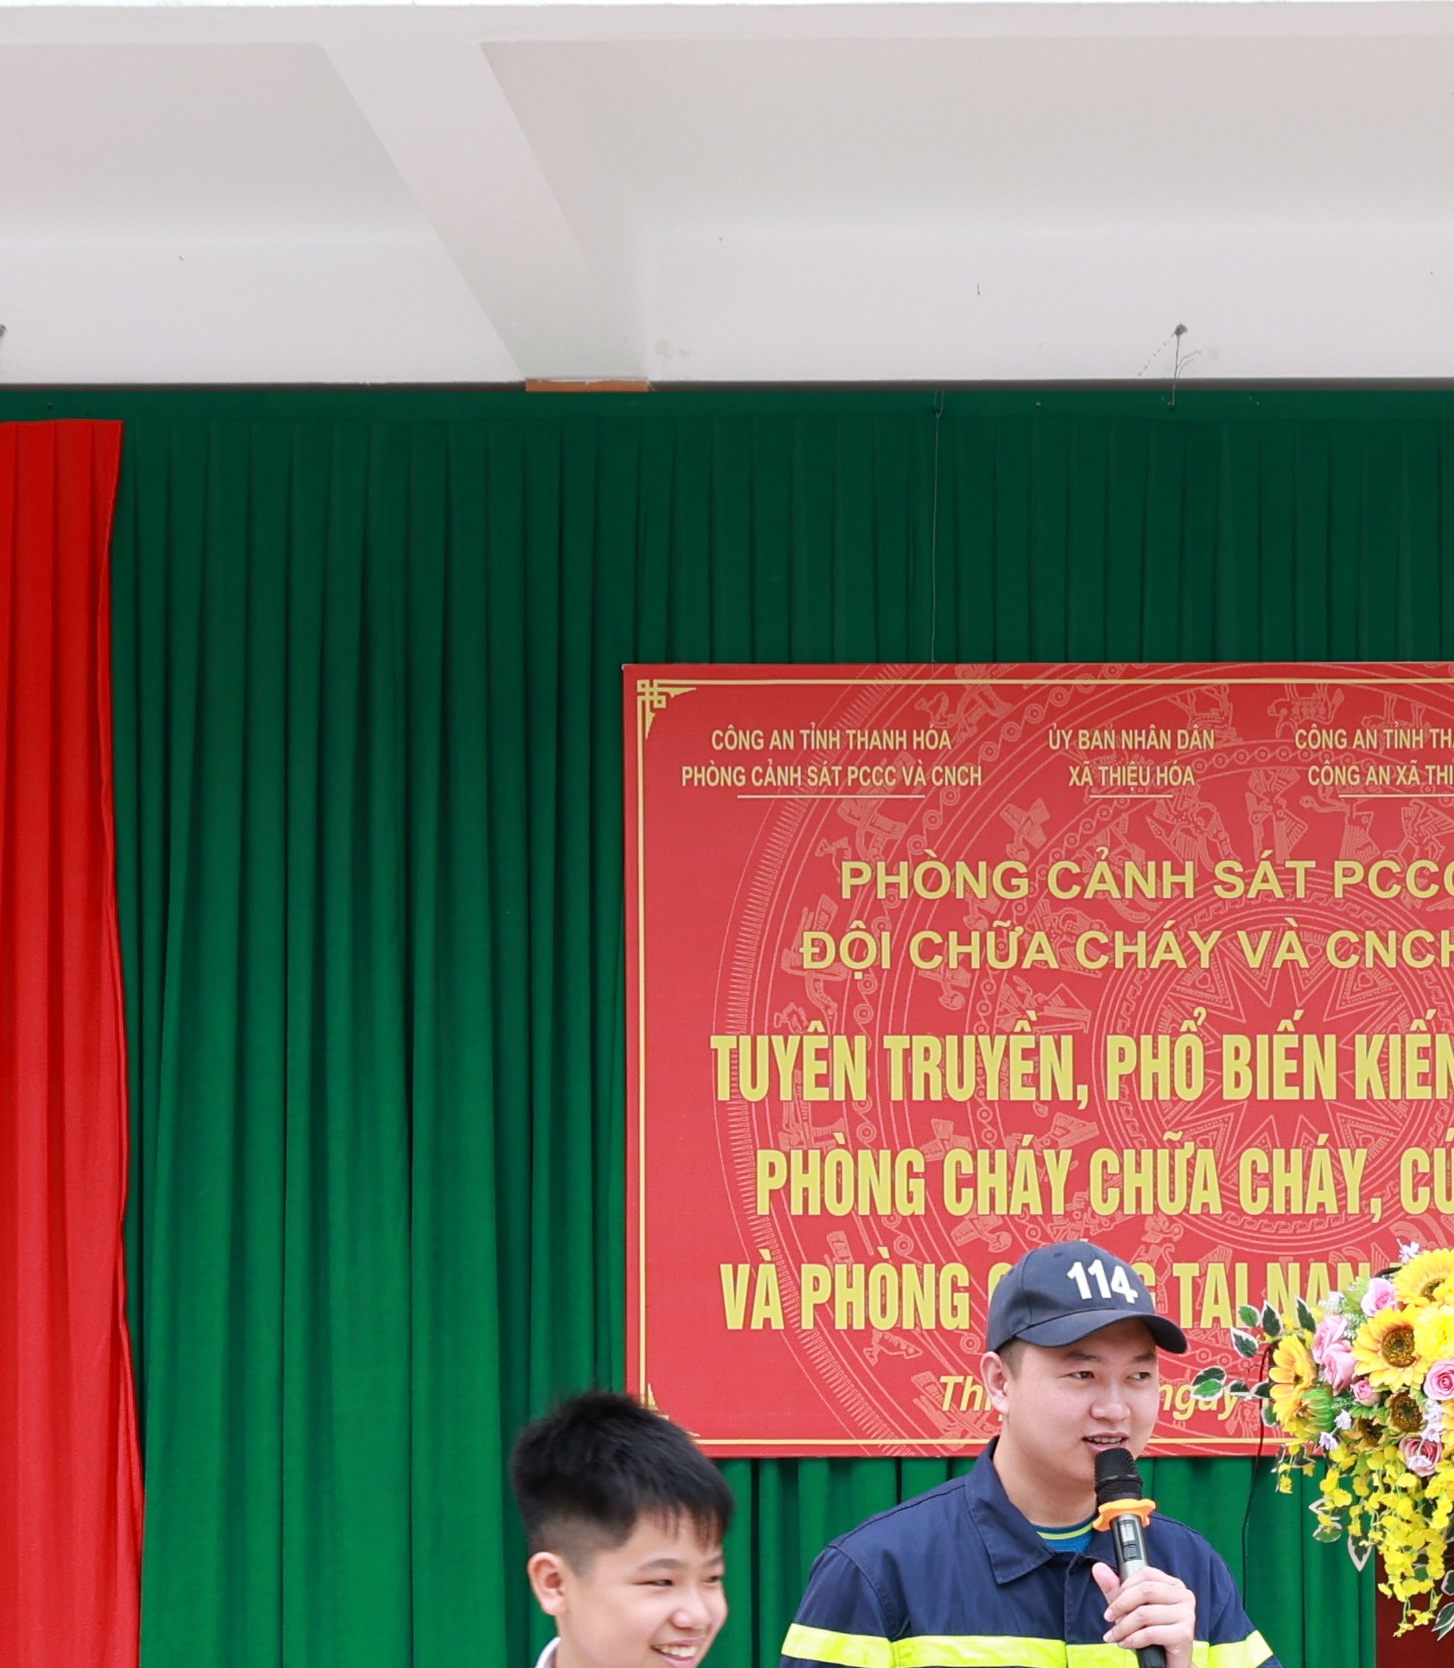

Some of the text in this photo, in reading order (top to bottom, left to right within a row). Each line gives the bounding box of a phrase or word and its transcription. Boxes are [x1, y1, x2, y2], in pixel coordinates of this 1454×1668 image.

[712, 722, 952, 750] CÔNG AN TỈNH THANH HÓA
[1048, 722, 1215, 750] ỦY BAN NHÂN DÂN
[1295, 724, 1348, 749] CÔNG
[1352, 729, 1378, 749] AN
[1383, 721, 1424, 749] TỈNH
[682, 759, 982, 786] PHÒNG CẢNH SÁT PCCC VÀ CNCH
[1069, 760, 1196, 792] XÃ THIỆU HÓA
[1308, 760, 1361, 785] CÔNG
[1366, 766, 1392, 785] AN
[1396, 759, 1421, 785] XÃ
[841, 850, 1030, 900] PHÒNG
[1047, 846, 1196, 899] CẢNH
[1213, 850, 1317, 899] SÁT
[800, 920, 892, 980] ĐỘI
[909, 920, 1060, 970] CHỮA
[1075, 920, 1222, 970] CHÁY
[1237, 918, 1310, 968] VÀ
[710, 1019, 869, 1102] TUYÊN
[883, 1010, 1090, 1109] TRUYỀN,
[1106, 1006, 1208, 1101] PHỔ
[1222, 1010, 1338, 1100] BIẾN
[756, 1132, 927, 1216] PHÒNG
[943, 1134, 1073, 1216] CHÁY
[1088, 1131, 1224, 1216] CHỮA
[1238, 1133, 1384, 1222] CHÁY,
[720, 1248, 786, 1330] VÀ
[800, 1247, 972, 1331] PHÒNG
[1067, 1259, 1139, 1304] 114
